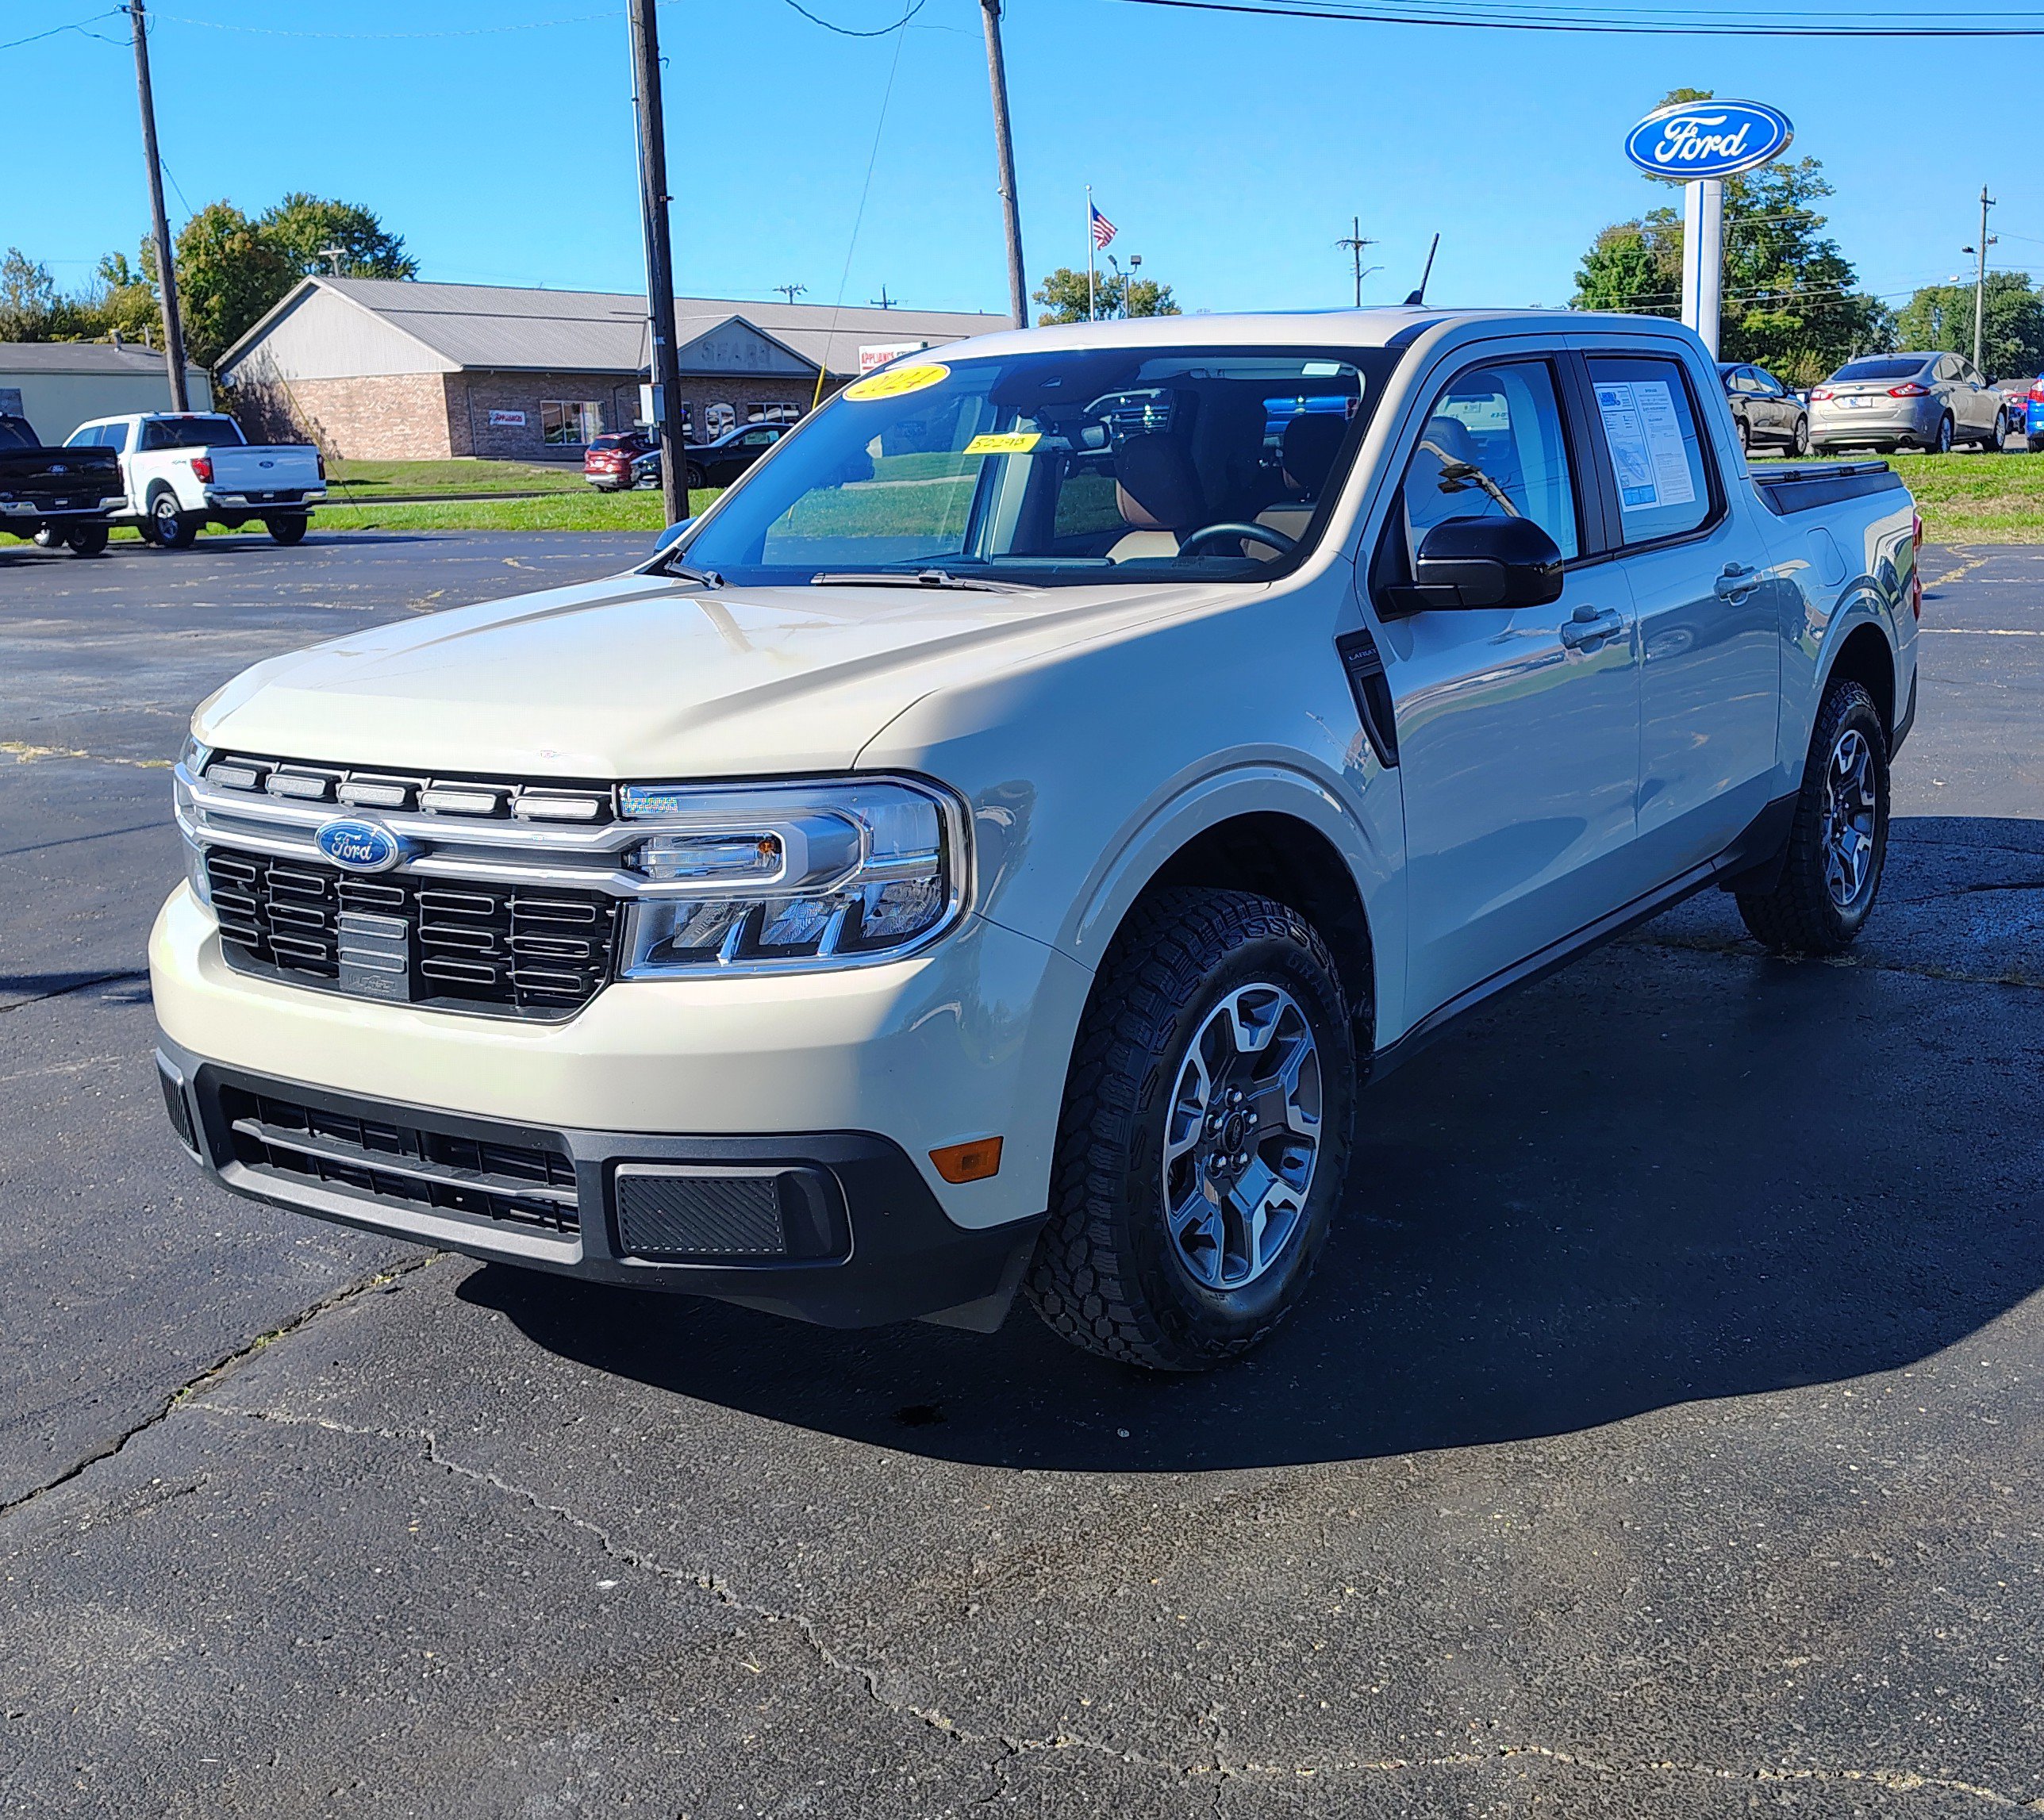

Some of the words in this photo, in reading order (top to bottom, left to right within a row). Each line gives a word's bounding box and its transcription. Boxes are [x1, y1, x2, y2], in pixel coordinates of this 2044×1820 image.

[1654, 116, 1751, 163] Ford
[1349, 648, 1377, 661] LARIAT
[332, 831, 373, 861] Ford
